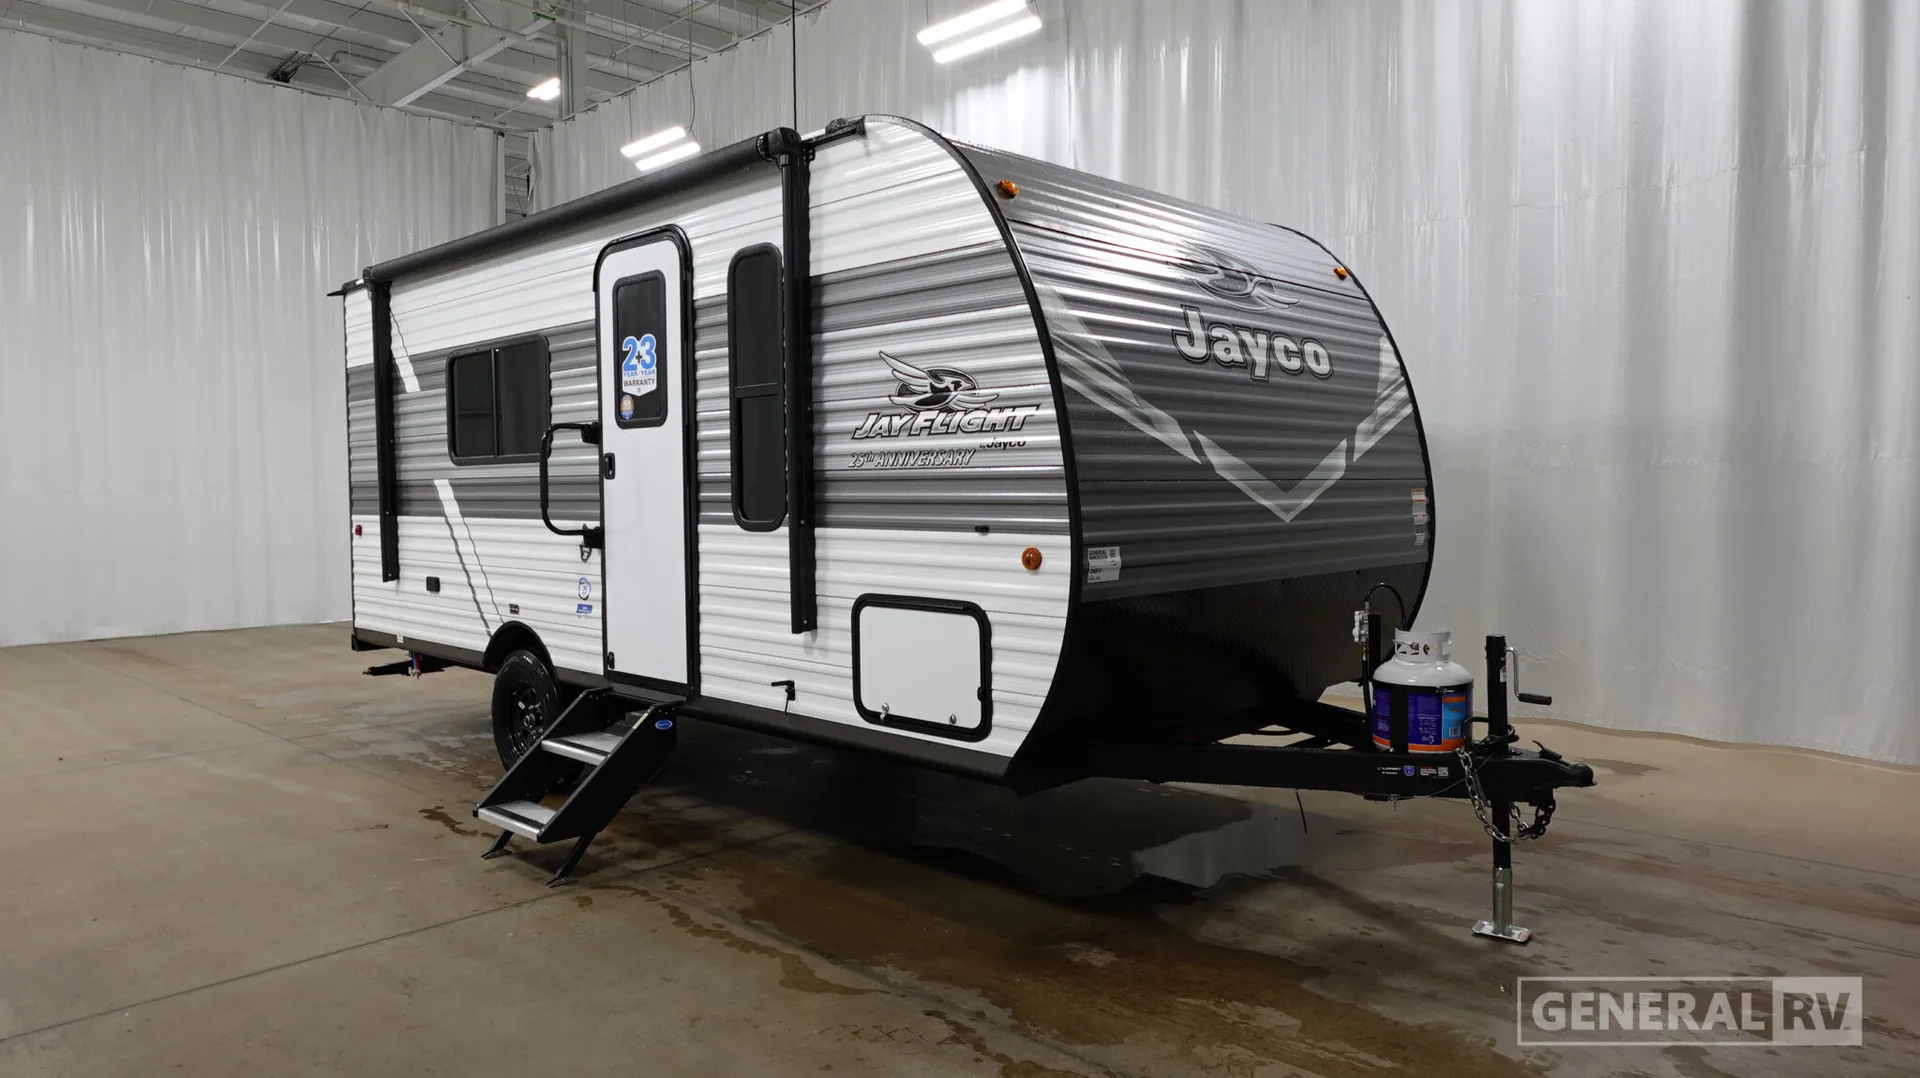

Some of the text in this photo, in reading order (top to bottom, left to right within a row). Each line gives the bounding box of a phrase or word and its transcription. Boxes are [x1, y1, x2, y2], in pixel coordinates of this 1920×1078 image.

[1172, 304, 1334, 382] Jayco
[624, 378, 655, 387] WARRANTY
[851, 403, 1041, 440] JAY FLIGHT
[848, 448, 976, 468] 25th ANNIVERSARY
